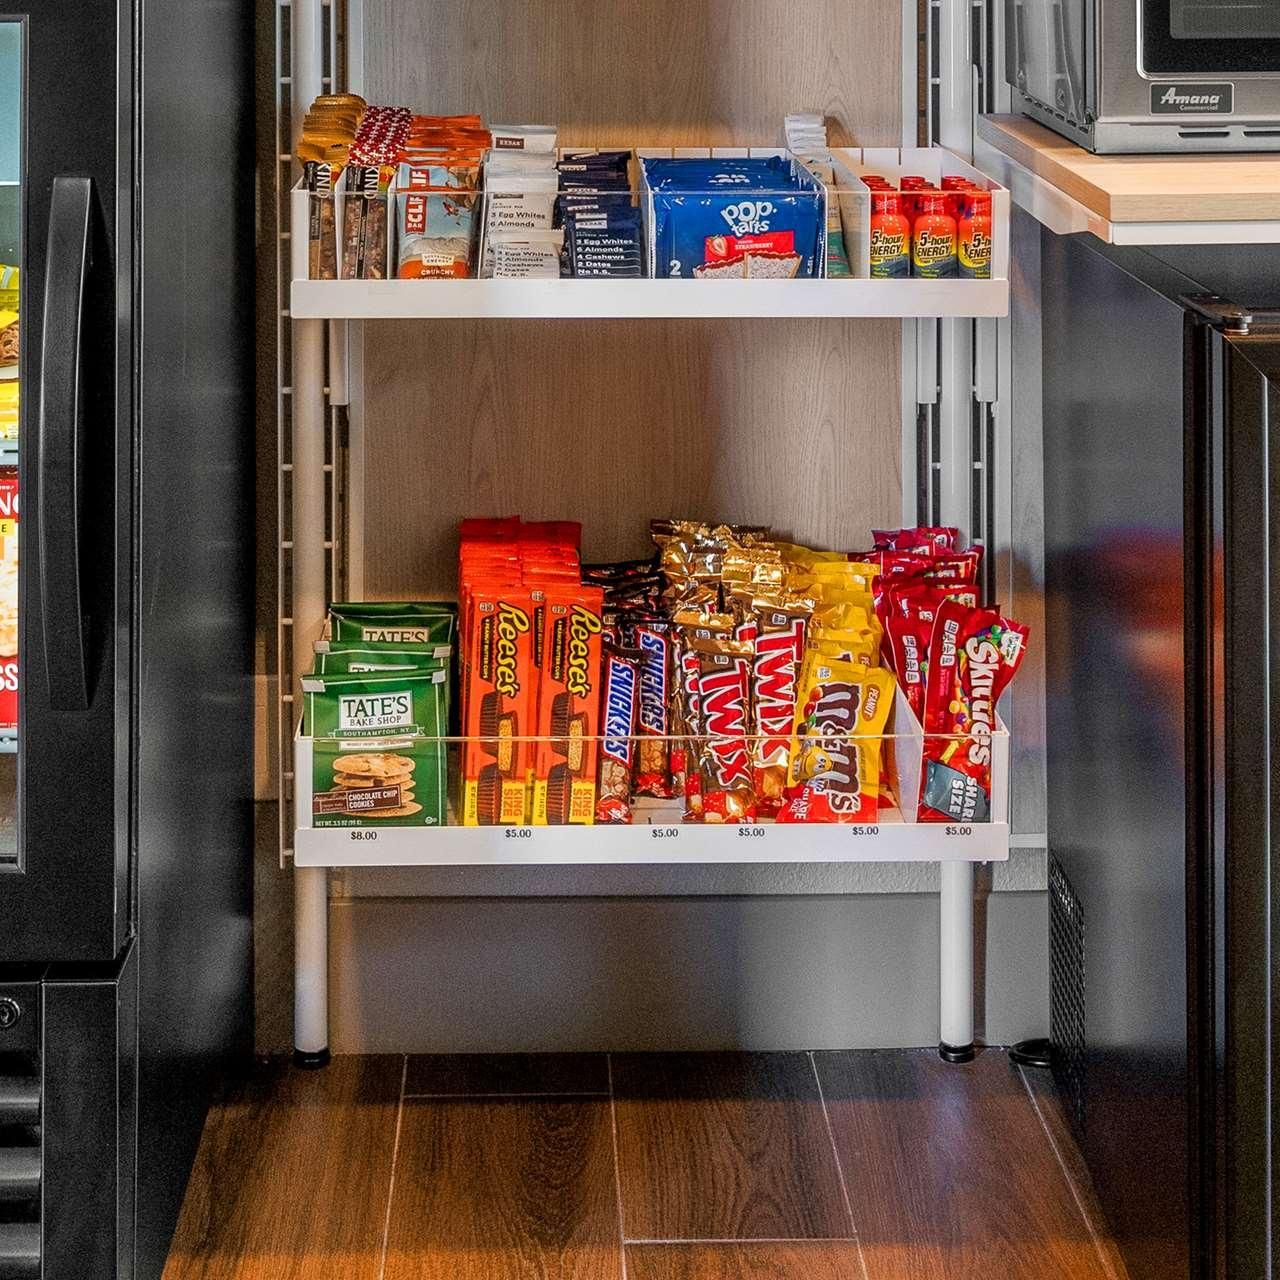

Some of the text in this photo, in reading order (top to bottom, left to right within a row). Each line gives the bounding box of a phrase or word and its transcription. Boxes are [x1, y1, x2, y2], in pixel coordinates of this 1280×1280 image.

[1160, 87, 1220, 104] Amana
[497, 602, 530, 698] Reese's
[568, 604, 602, 699] Reese's
[755, 620, 806, 772] TWIX
[343, 695, 409, 718] TATE'S
[350, 716, 402, 727] BAKE SHOP
[698, 661, 752, 788] TWIX
[351, 830, 377, 841] $8.00
[505, 828, 531, 838] $5.00
[652, 828, 678, 838] $5.00
[738, 827, 765, 837] $5.00
[852, 825, 879, 836] $5.00
[945, 825, 972, 836] $5.00
